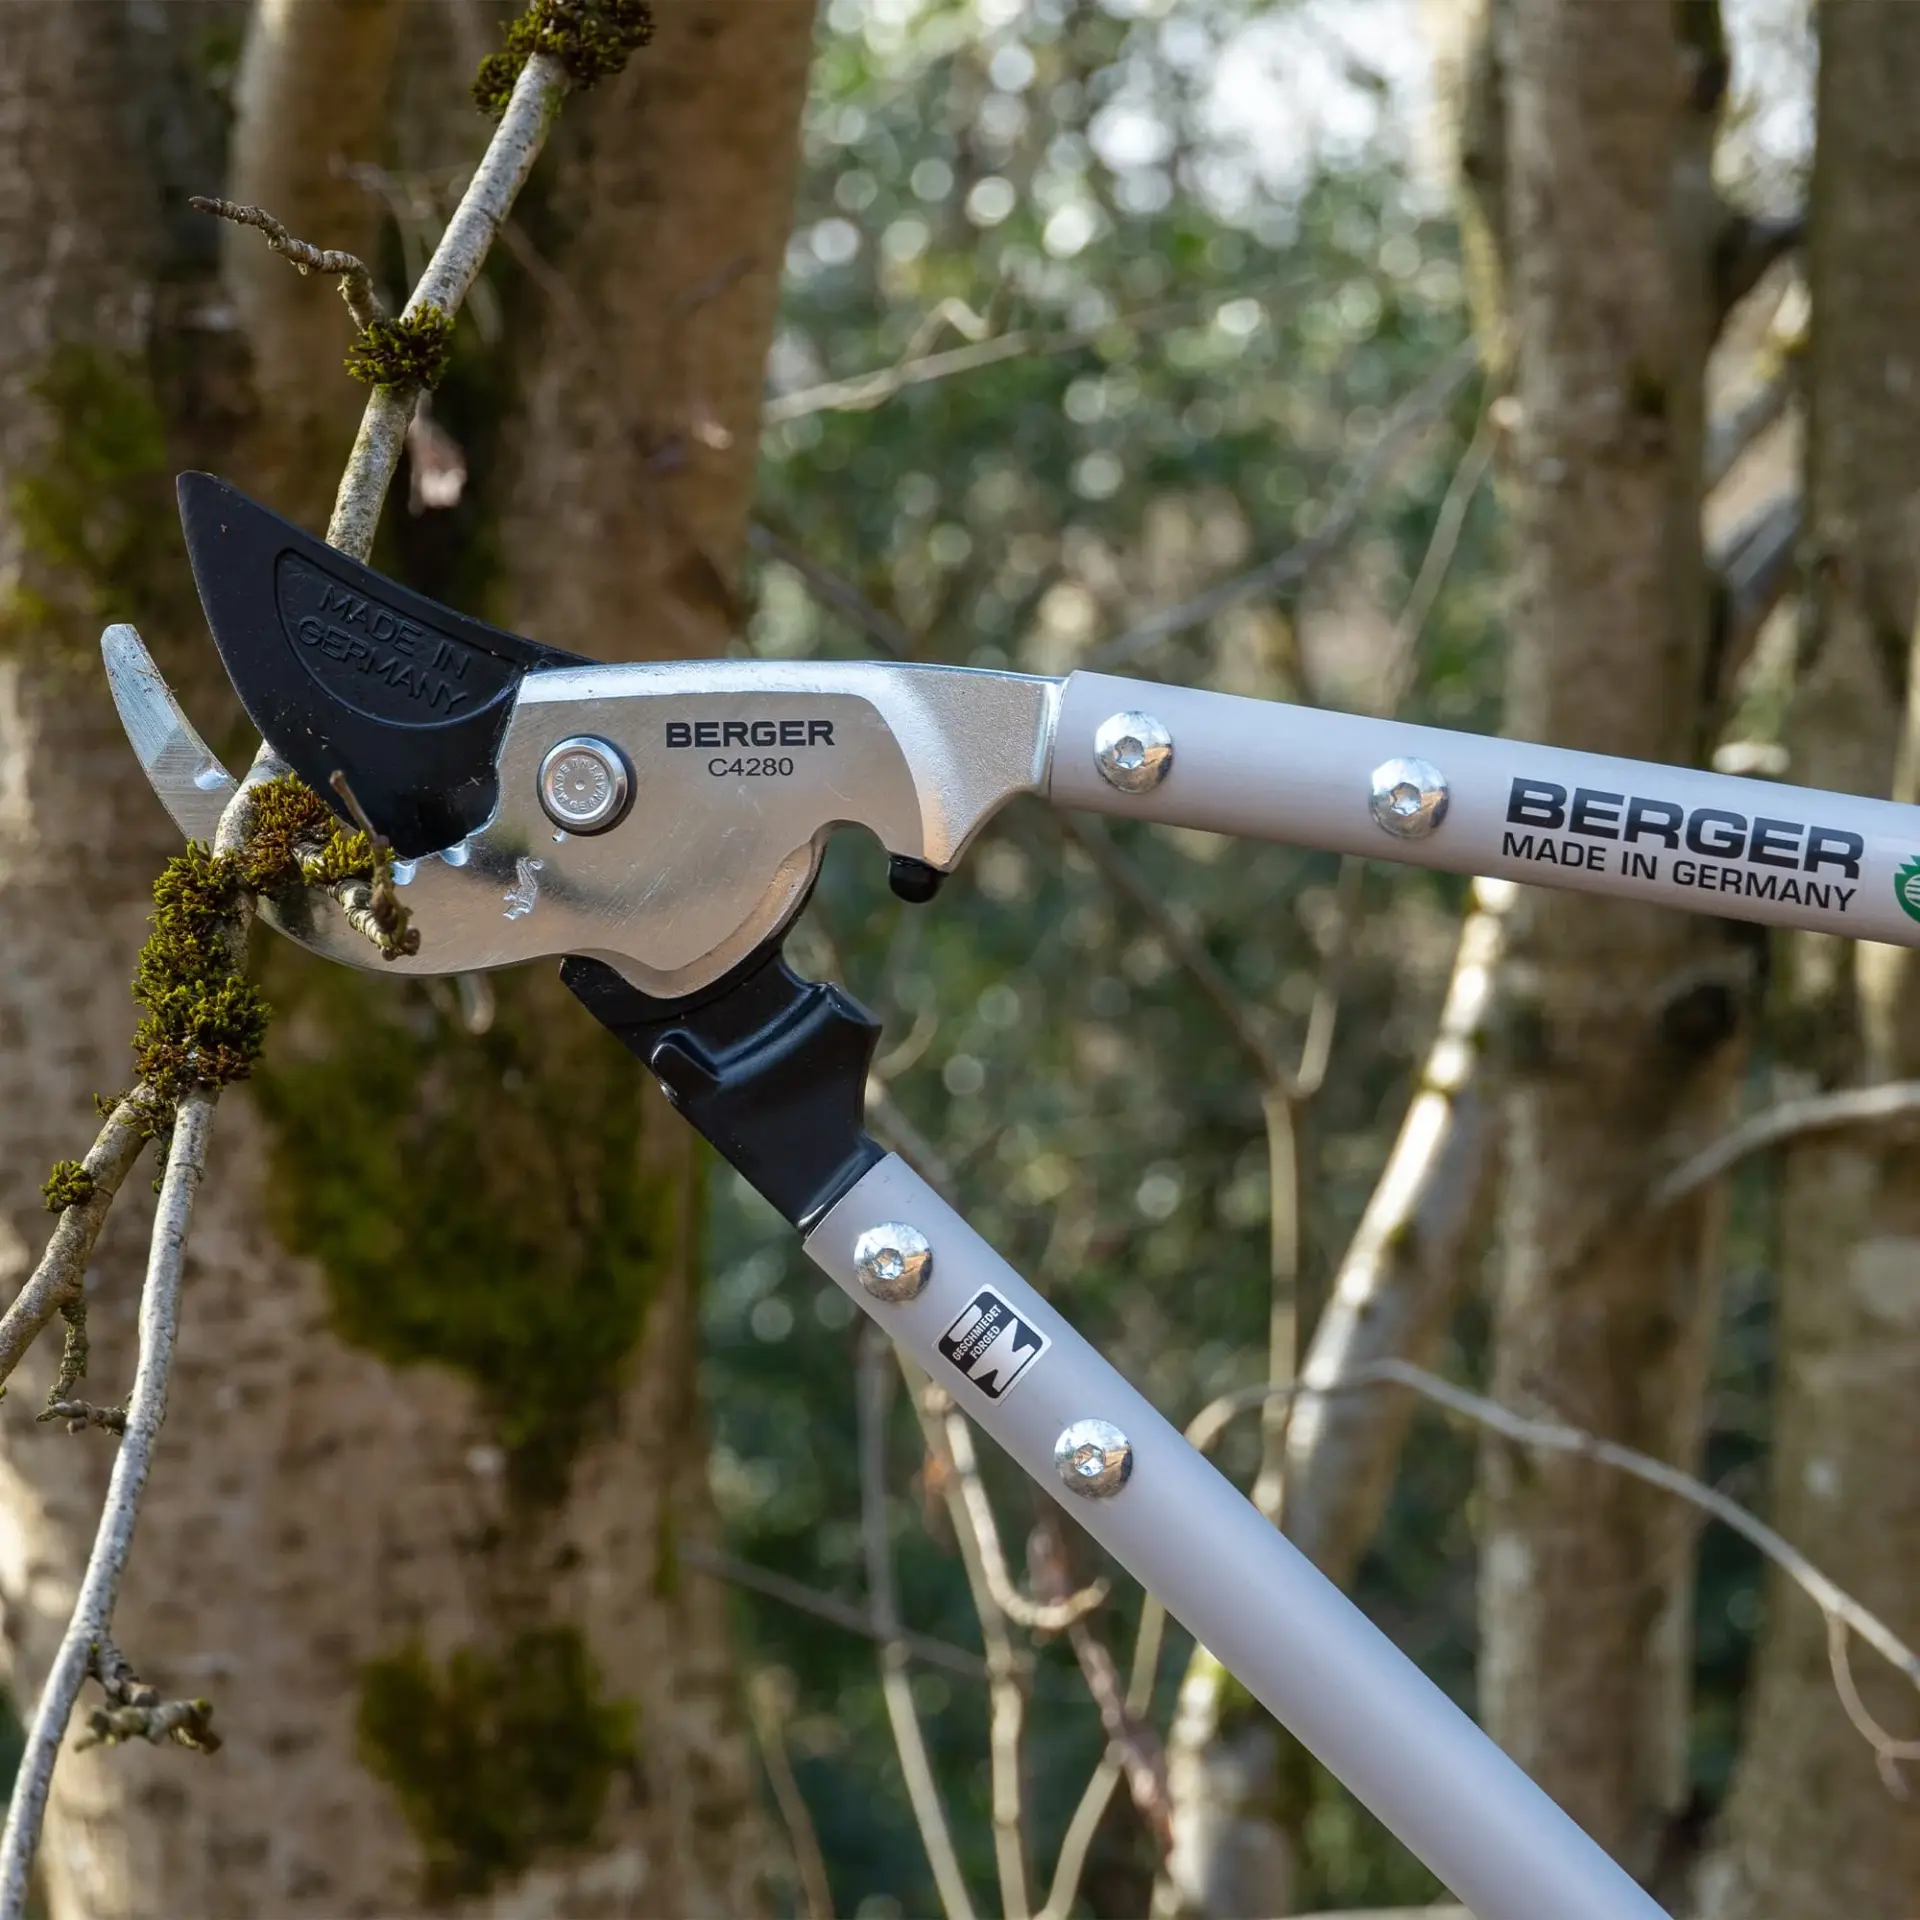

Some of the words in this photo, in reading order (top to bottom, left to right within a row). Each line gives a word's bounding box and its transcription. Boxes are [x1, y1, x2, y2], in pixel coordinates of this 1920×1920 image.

[299, 616, 468, 714] GERMANY
[318, 584, 422, 656] MADE
[432, 639, 471, 680] IN
[666, 720, 835, 748] BERGER
[708, 758, 794, 777] C4280
[1506, 777, 1864, 880] BERGER
[1502, 832, 1606, 871] MADE
[1621, 851, 1658, 880] IN
[1672, 861, 1858, 911] GERMANY
[952, 1304, 1002, 1361] GESCHMIEDET
[970, 1325, 1001, 1360] FORGED
